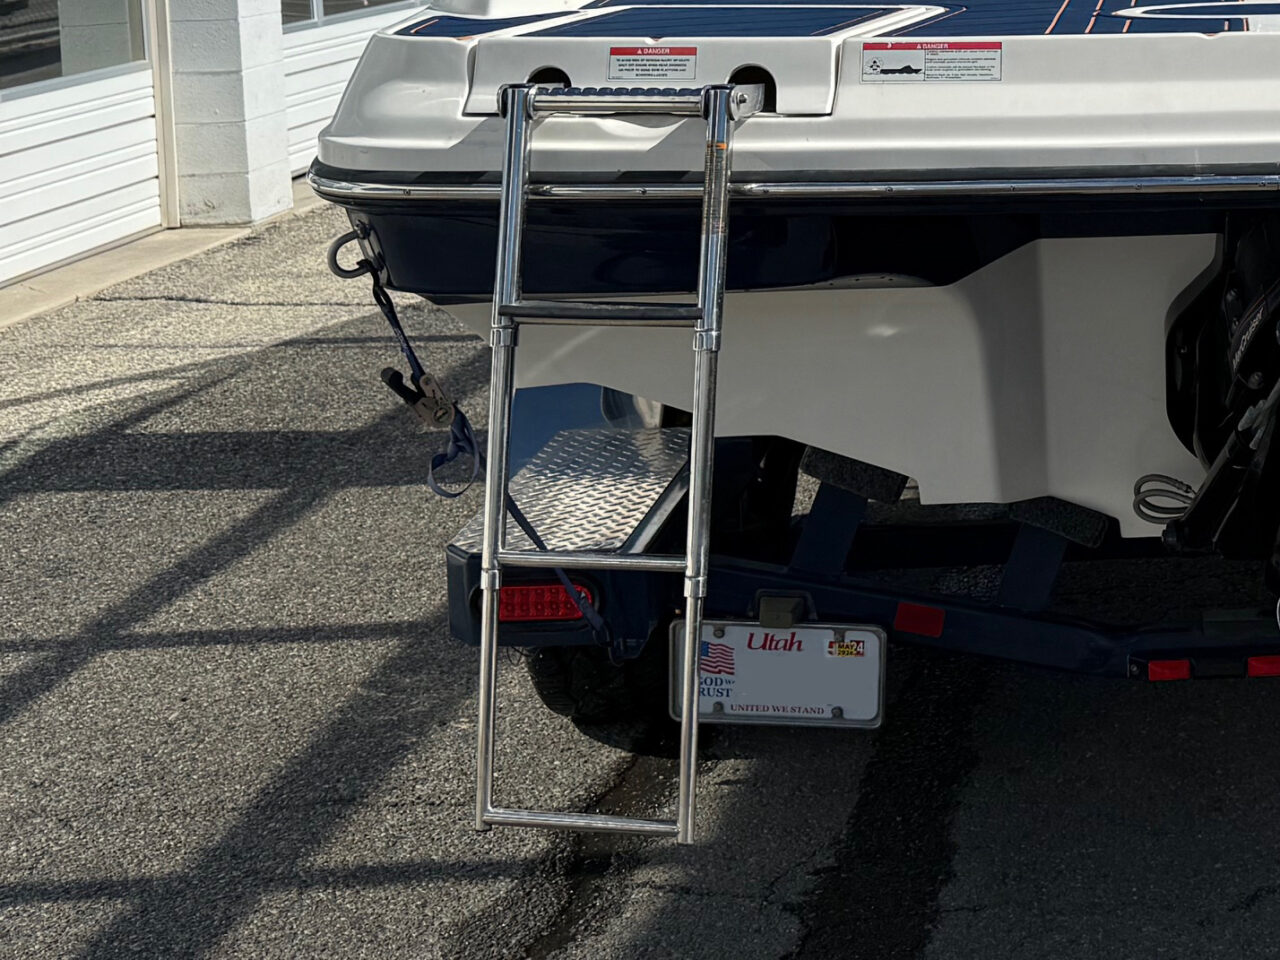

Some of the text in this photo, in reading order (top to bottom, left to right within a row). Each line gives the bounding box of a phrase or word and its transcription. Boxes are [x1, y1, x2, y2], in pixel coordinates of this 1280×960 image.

[747, 632, 803, 651] Utah
[700, 688, 733, 698] RUST
[730, 704, 824, 715] UNITED WE STAND
